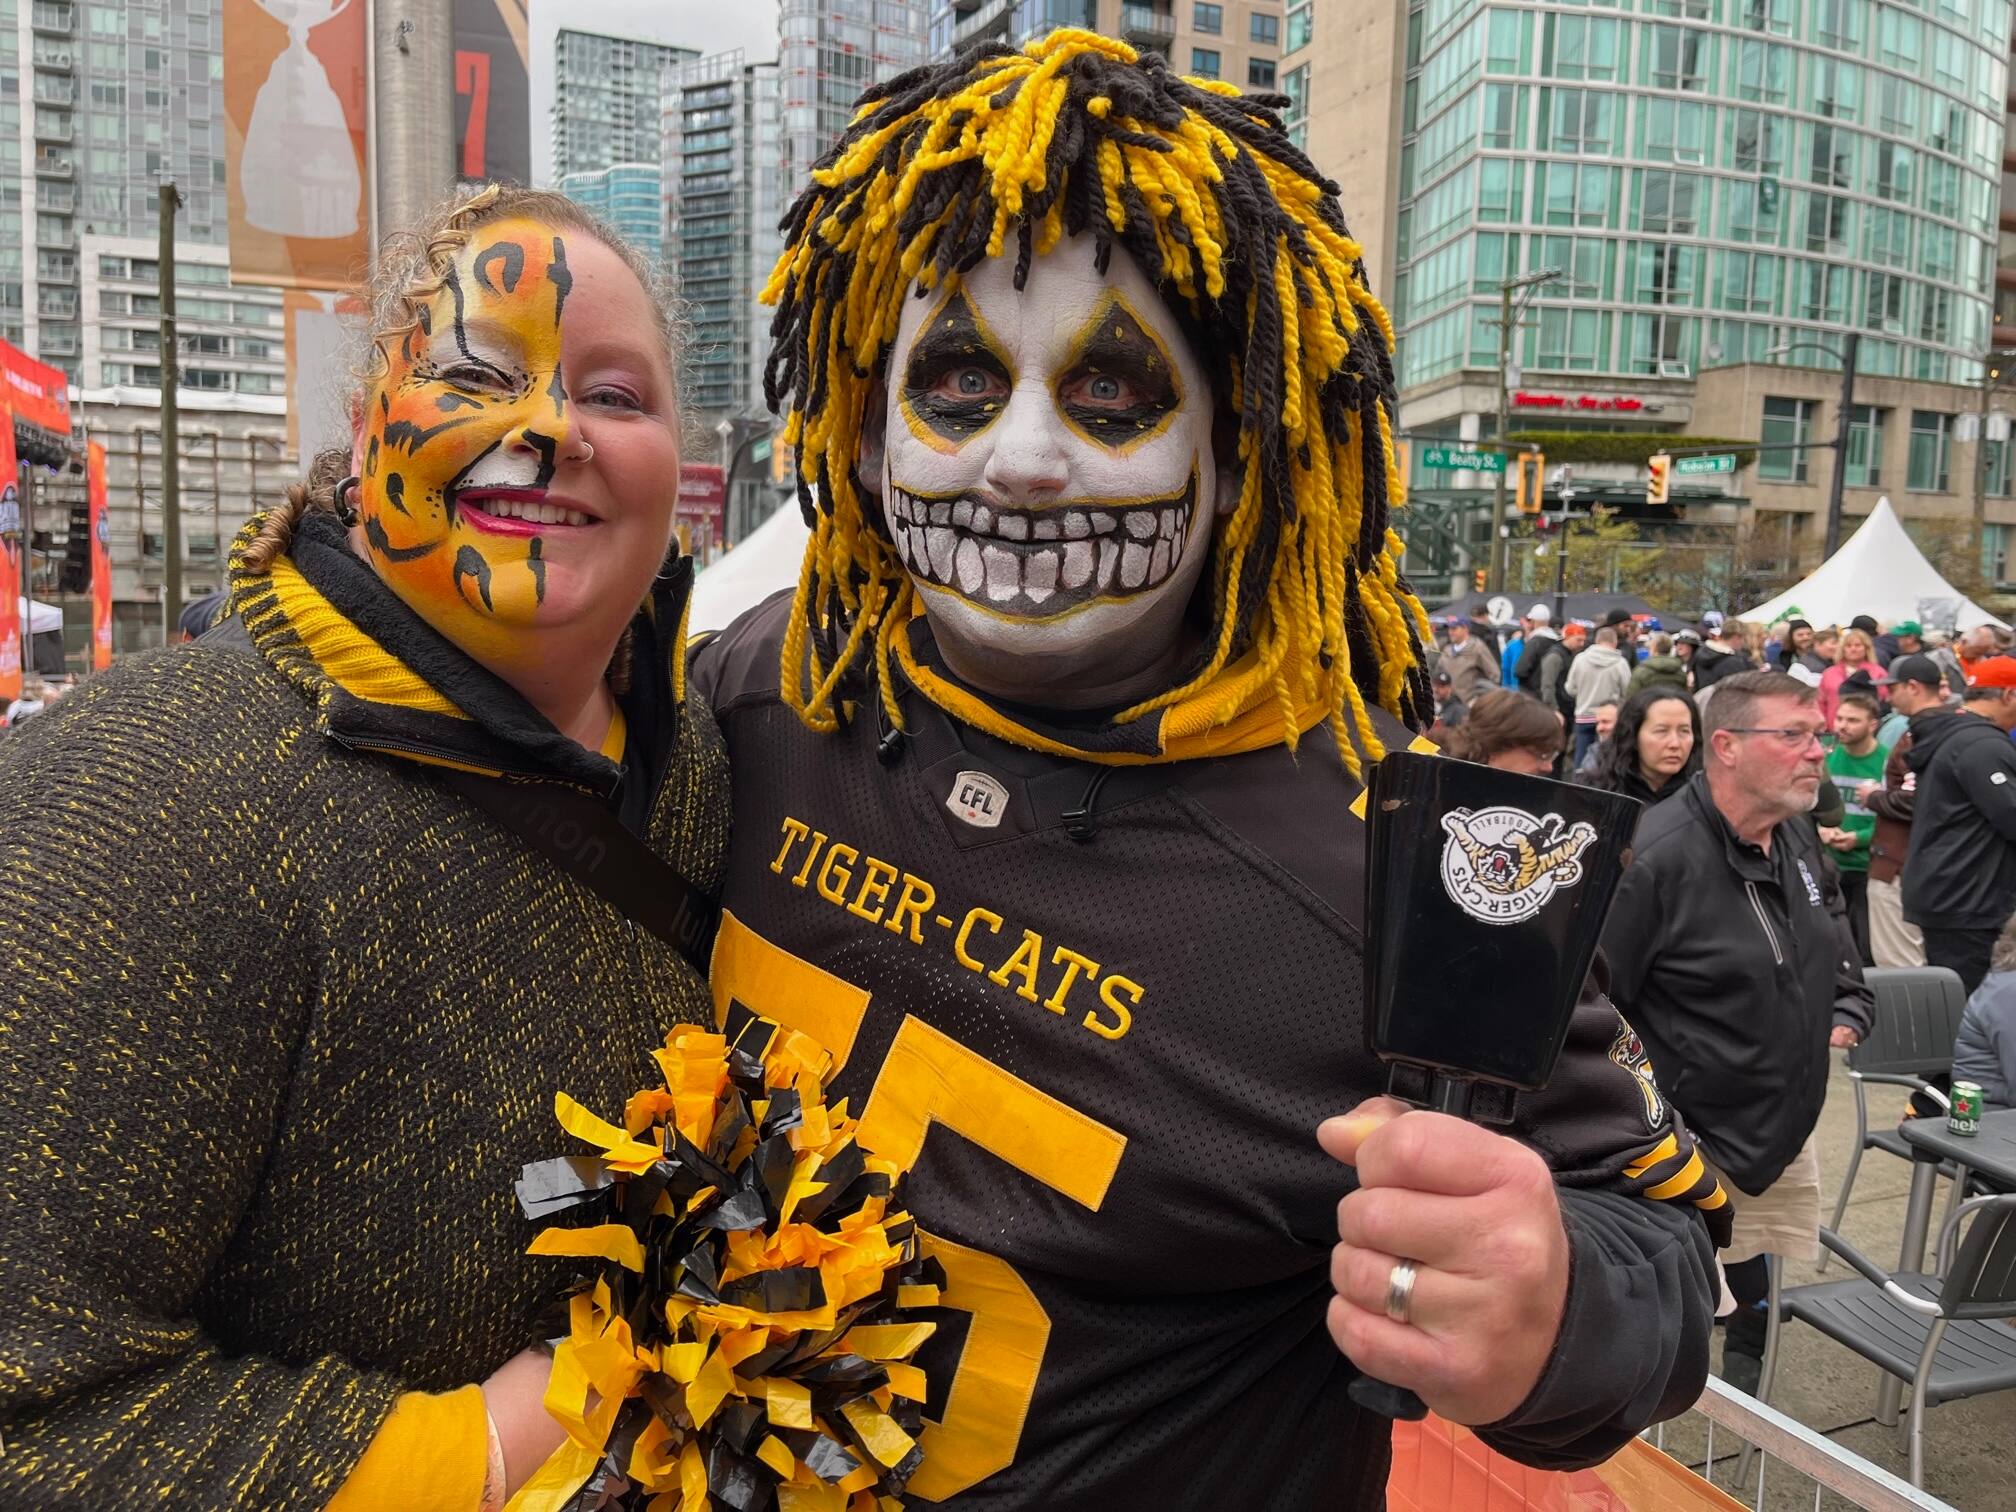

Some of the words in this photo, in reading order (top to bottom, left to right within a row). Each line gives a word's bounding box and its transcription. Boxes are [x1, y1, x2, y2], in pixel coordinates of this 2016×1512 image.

[960, 784, 993, 816] CFL
[1473, 814, 1531, 832] FOOTBALL
[1453, 866, 1543, 914] TIGER-CATS
[769, 816, 1145, 1041] TIGER-CATS
